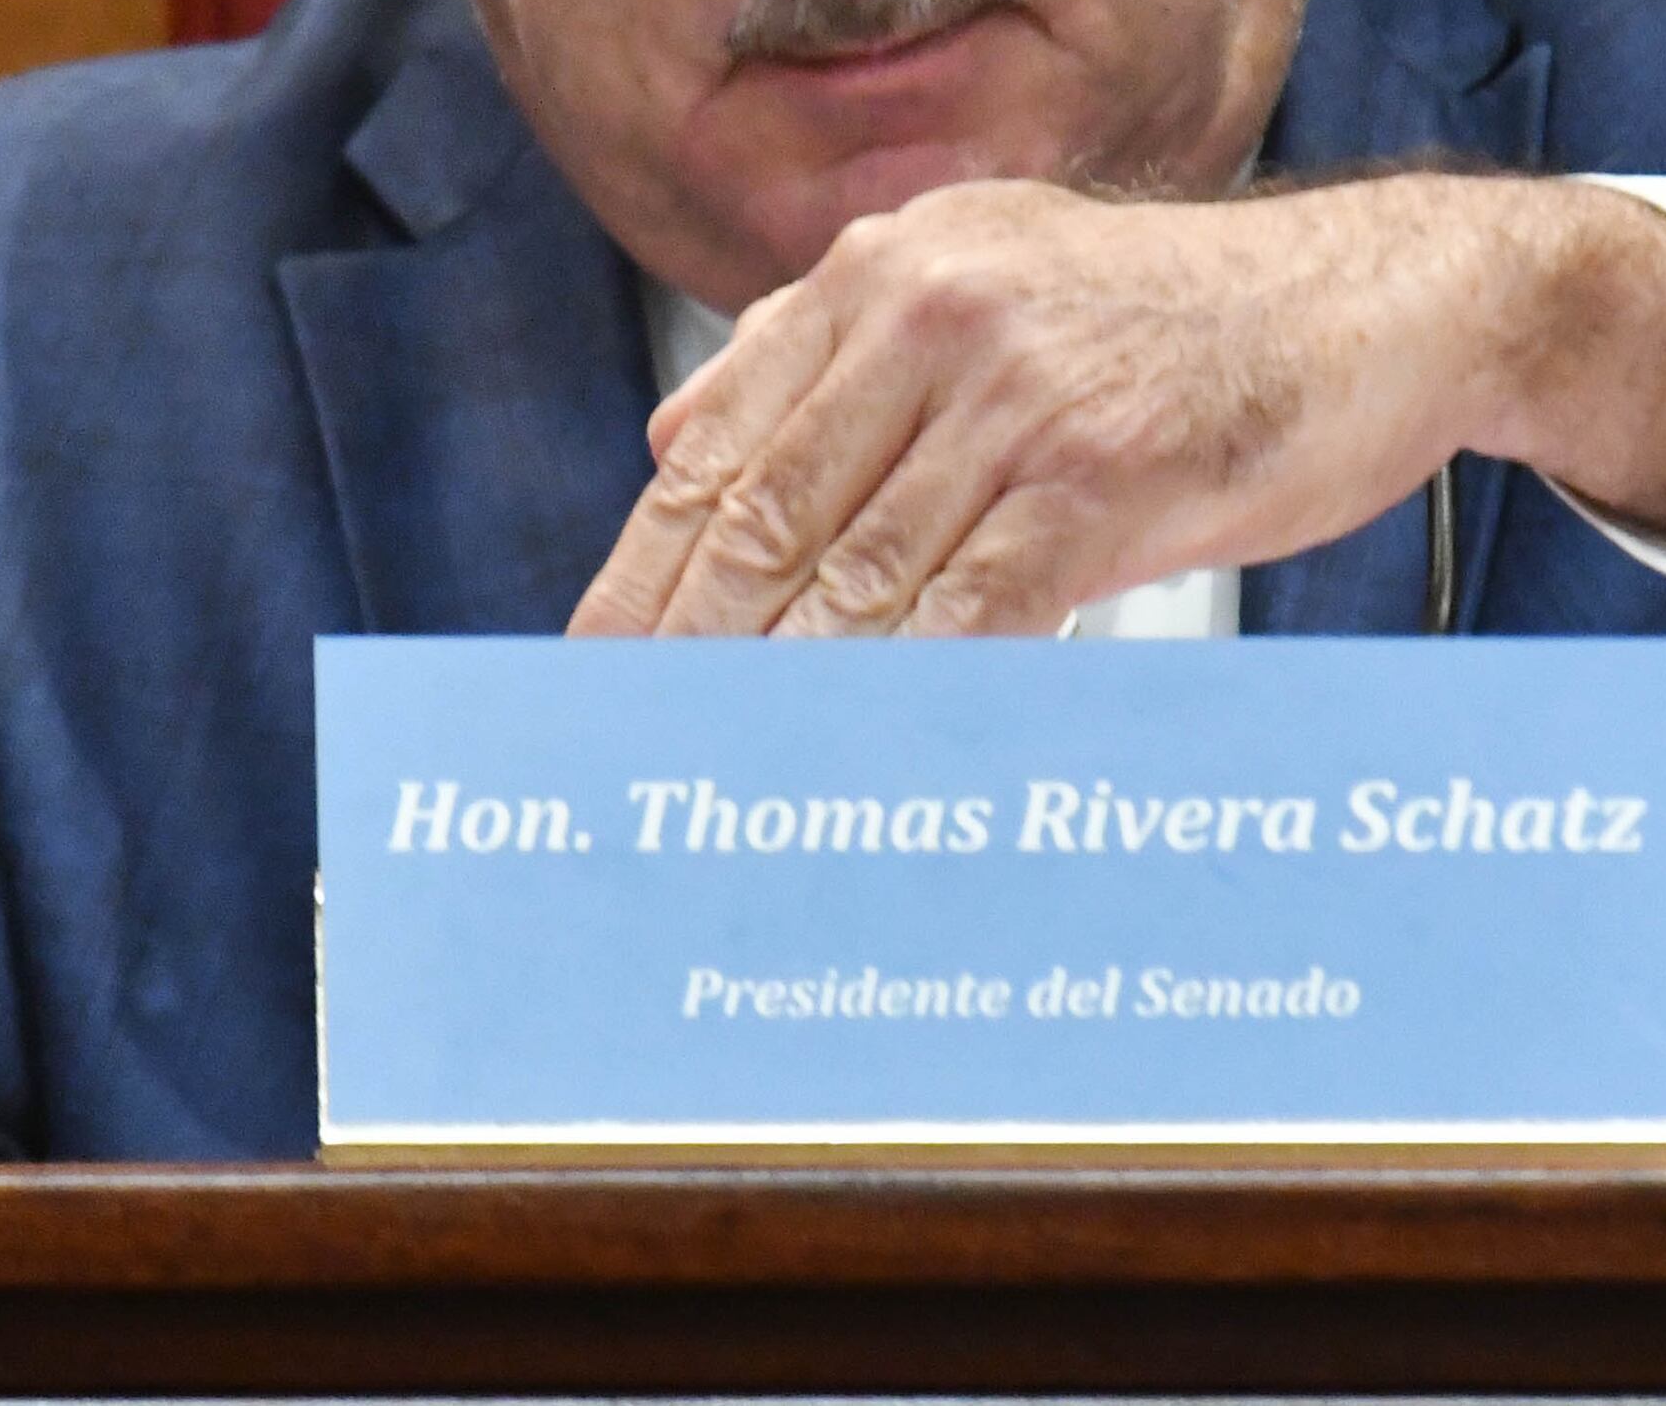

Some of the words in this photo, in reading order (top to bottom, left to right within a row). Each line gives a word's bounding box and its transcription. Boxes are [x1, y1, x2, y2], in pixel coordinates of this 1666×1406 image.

[388, 780, 592, 854] Hon.
[628, 778, 993, 854] Thomas
[1018, 779, 1316, 854] Rivera
[1339, 777, 1647, 854] Schatz
[682, 966, 1012, 1019] Presidente
[1026, 965, 1123, 1018] del
[1134, 966, 1361, 1018] Senado
